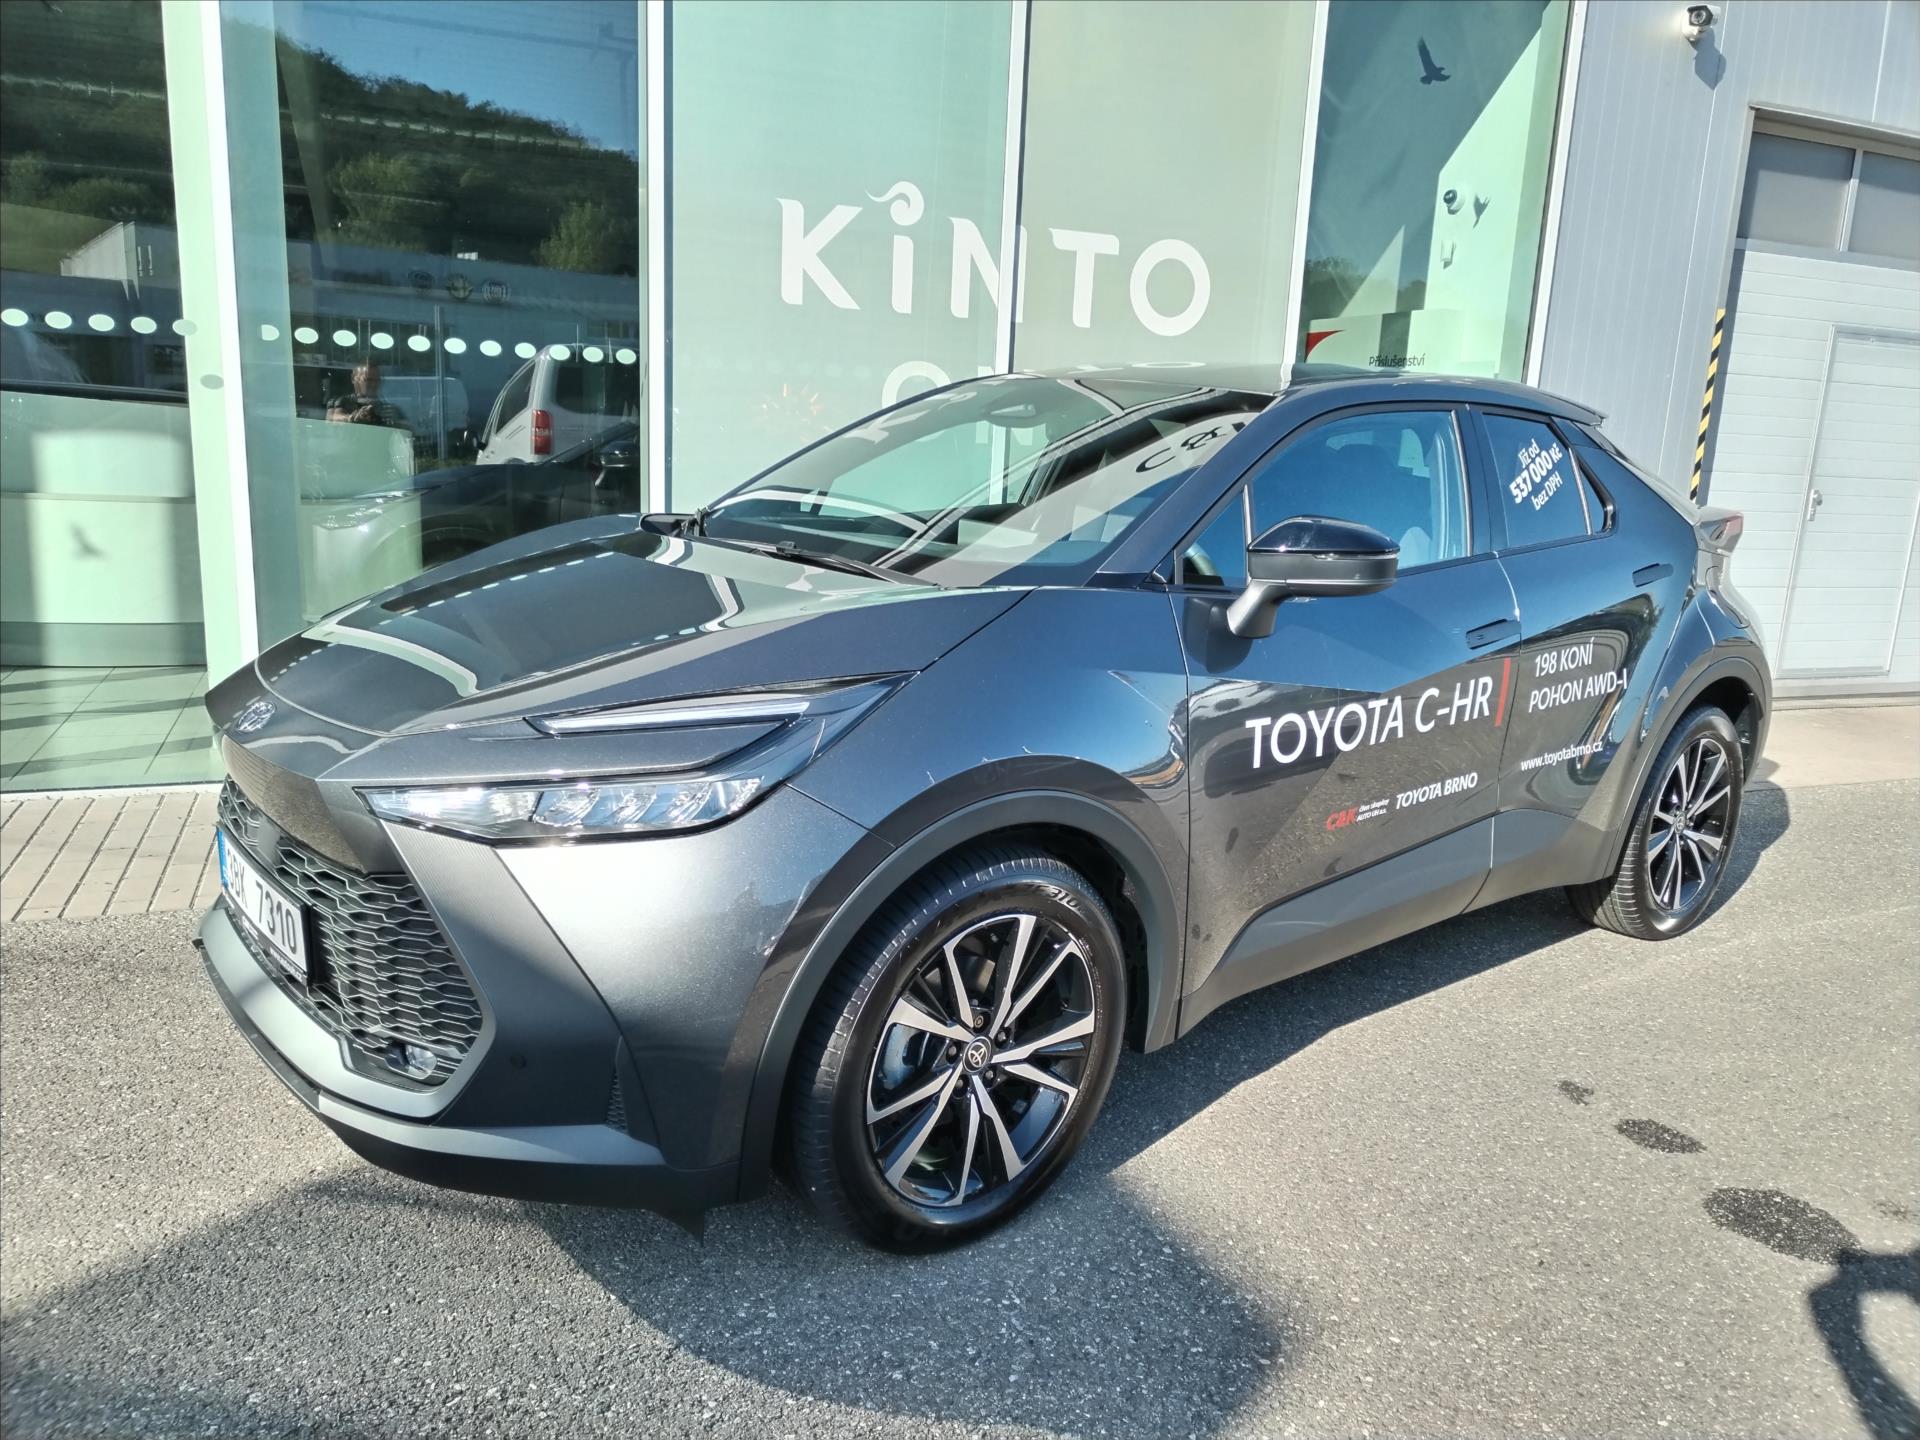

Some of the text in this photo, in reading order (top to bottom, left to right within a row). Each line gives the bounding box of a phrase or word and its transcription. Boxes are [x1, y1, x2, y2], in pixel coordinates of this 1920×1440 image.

[1368, 353, 1425, 367] Příslušenství
[1528, 437, 1541, 458] od
[1509, 442, 1563, 504] 537 000 Kč
[1531, 471, 1563, 511] bez DPH
[1535, 636, 1595, 678] 198 KONÍ
[1528, 667, 1628, 714] POHON AWD-I
[1245, 676, 1493, 769] TOYOTA C-HR
[1520, 741, 1603, 772] www.toyotabrno.cz
[1395, 772, 1479, 810] TOYOTA BRNO
[255, 879, 297, 955] 7310
